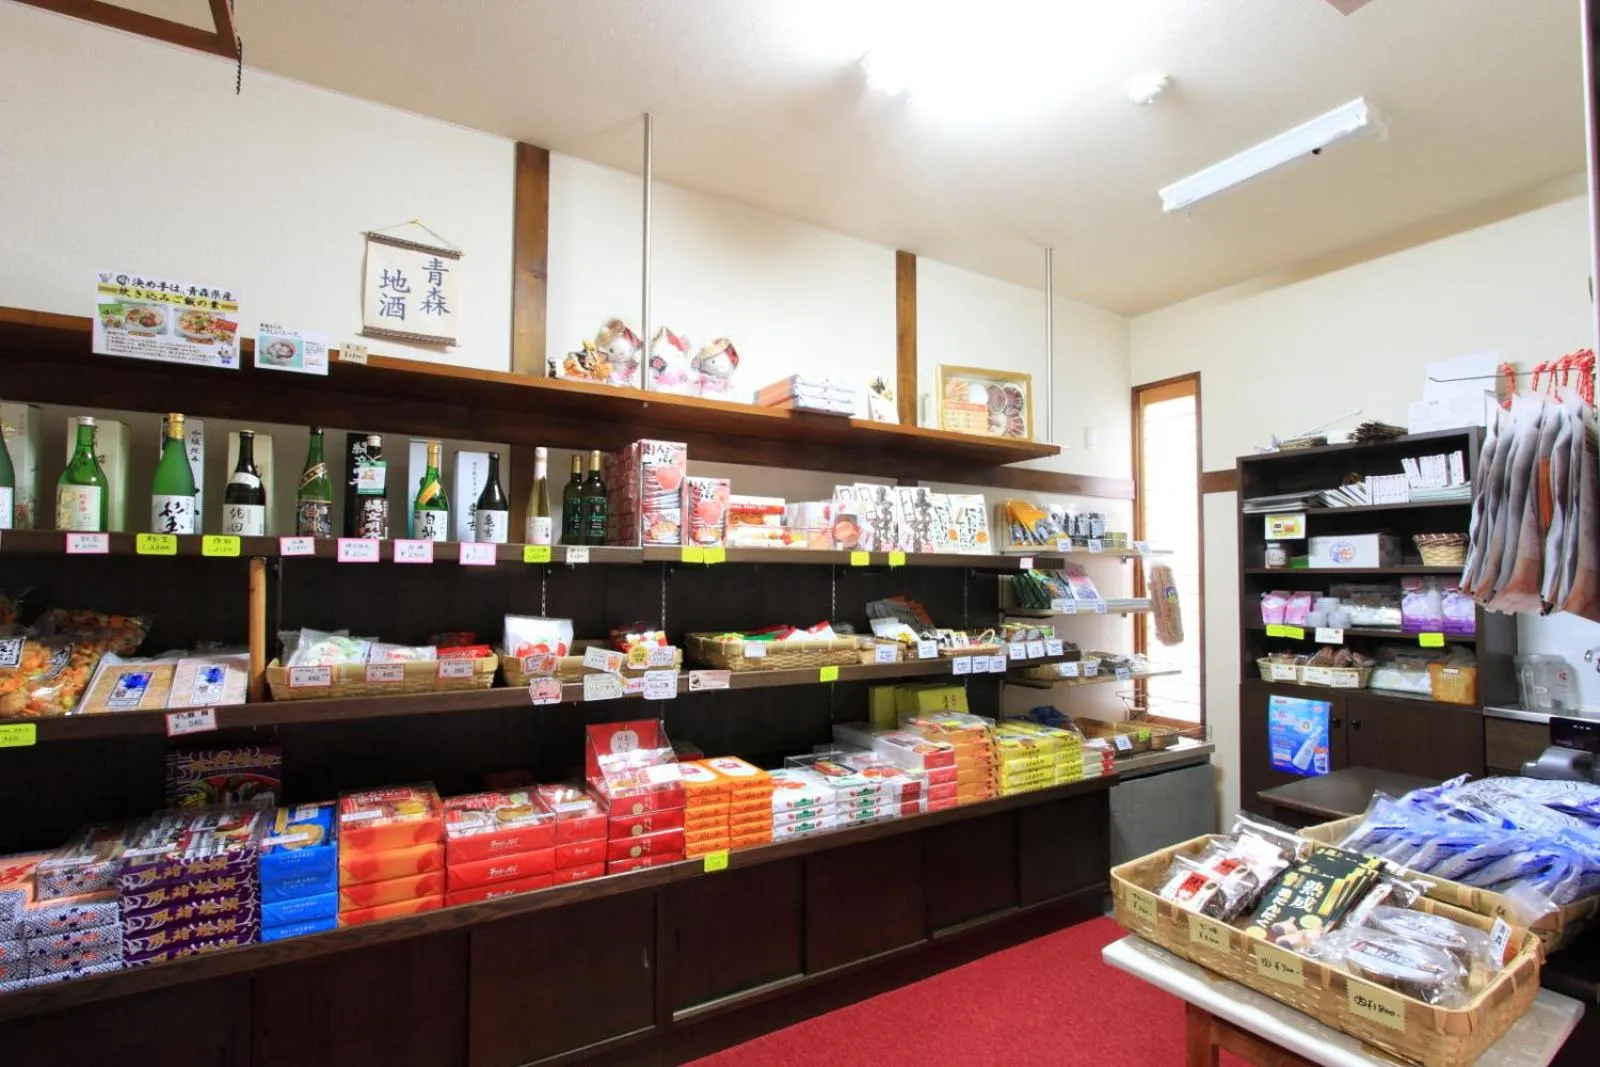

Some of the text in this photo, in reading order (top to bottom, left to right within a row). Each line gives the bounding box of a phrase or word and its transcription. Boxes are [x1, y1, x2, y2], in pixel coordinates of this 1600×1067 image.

[132, 276, 233, 301] 決め手は、青森県産
[379, 268, 411, 321] 地酒
[421, 257, 450, 316] 青森
[158, 500, 185, 534] 杉玉
